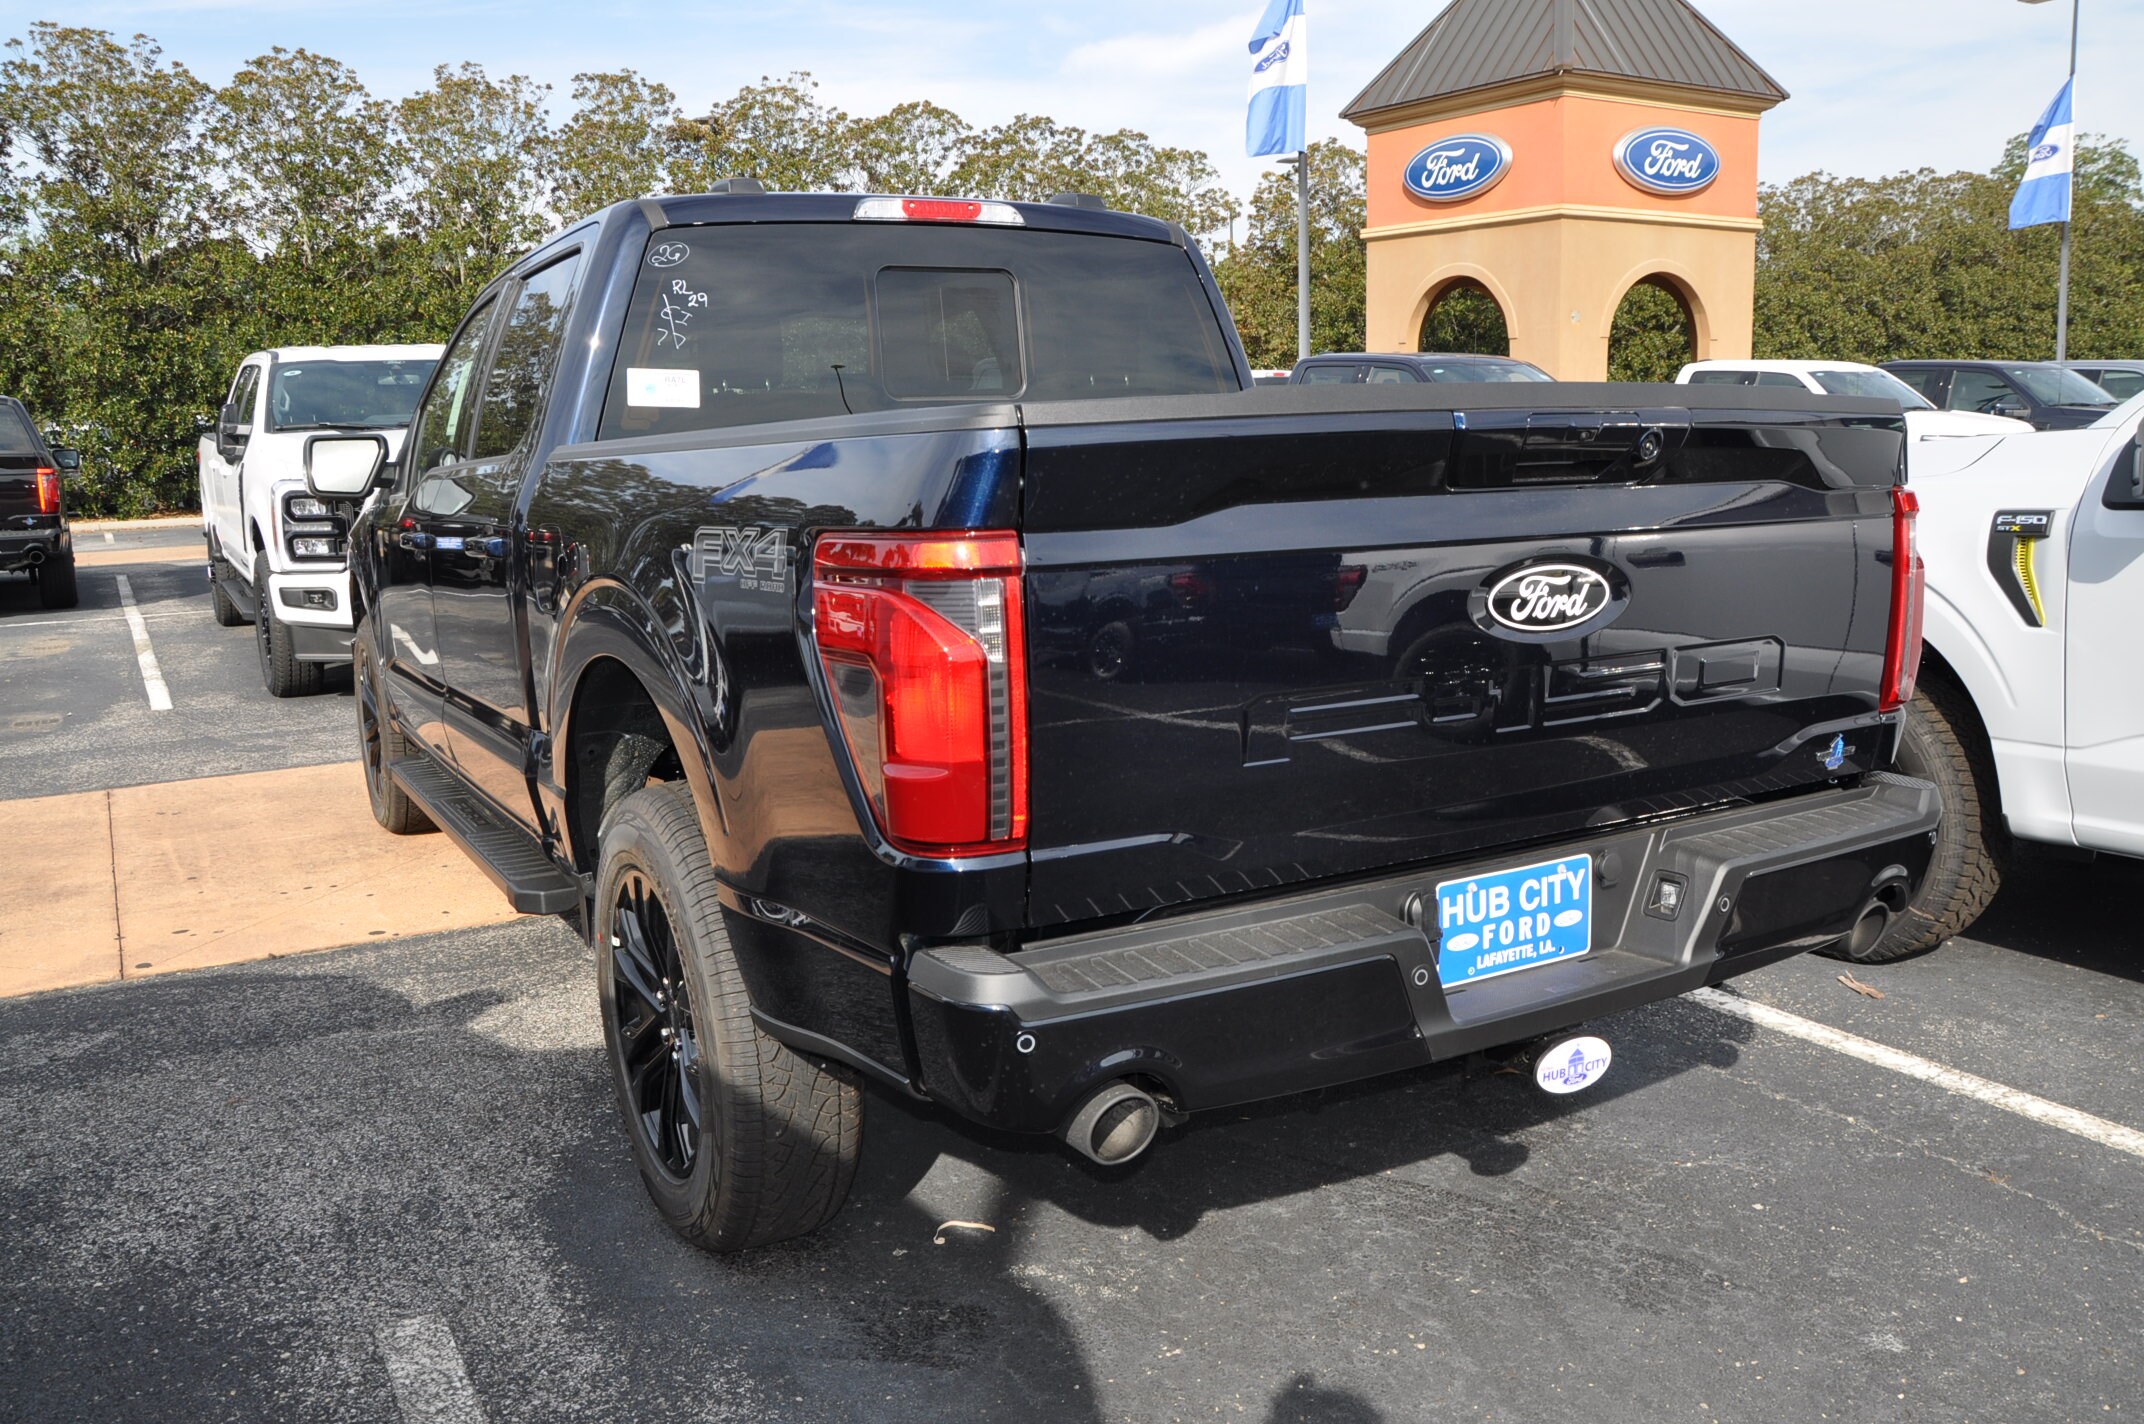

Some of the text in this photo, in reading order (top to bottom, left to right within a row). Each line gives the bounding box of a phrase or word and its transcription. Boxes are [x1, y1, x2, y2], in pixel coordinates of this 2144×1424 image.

[1421, 147, 1481, 188] Ford
[1643, 138, 1703, 179] Ford
[687, 292, 708, 307] 29
[1996, 515, 2048, 524] F-150
[692, 526, 788, 584] FX4
[1509, 575, 1589, 622] Ford
[1242, 634, 1787, 767] F-150
[1442, 868, 1586, 928] HUB CITY
[1482, 912, 1551, 949] FORD
[1476, 940, 1556, 969] LAFAYETTE, LA.
[1543, 1068, 1566, 1083] HUB
[1584, 1056, 1608, 1072] CITY
